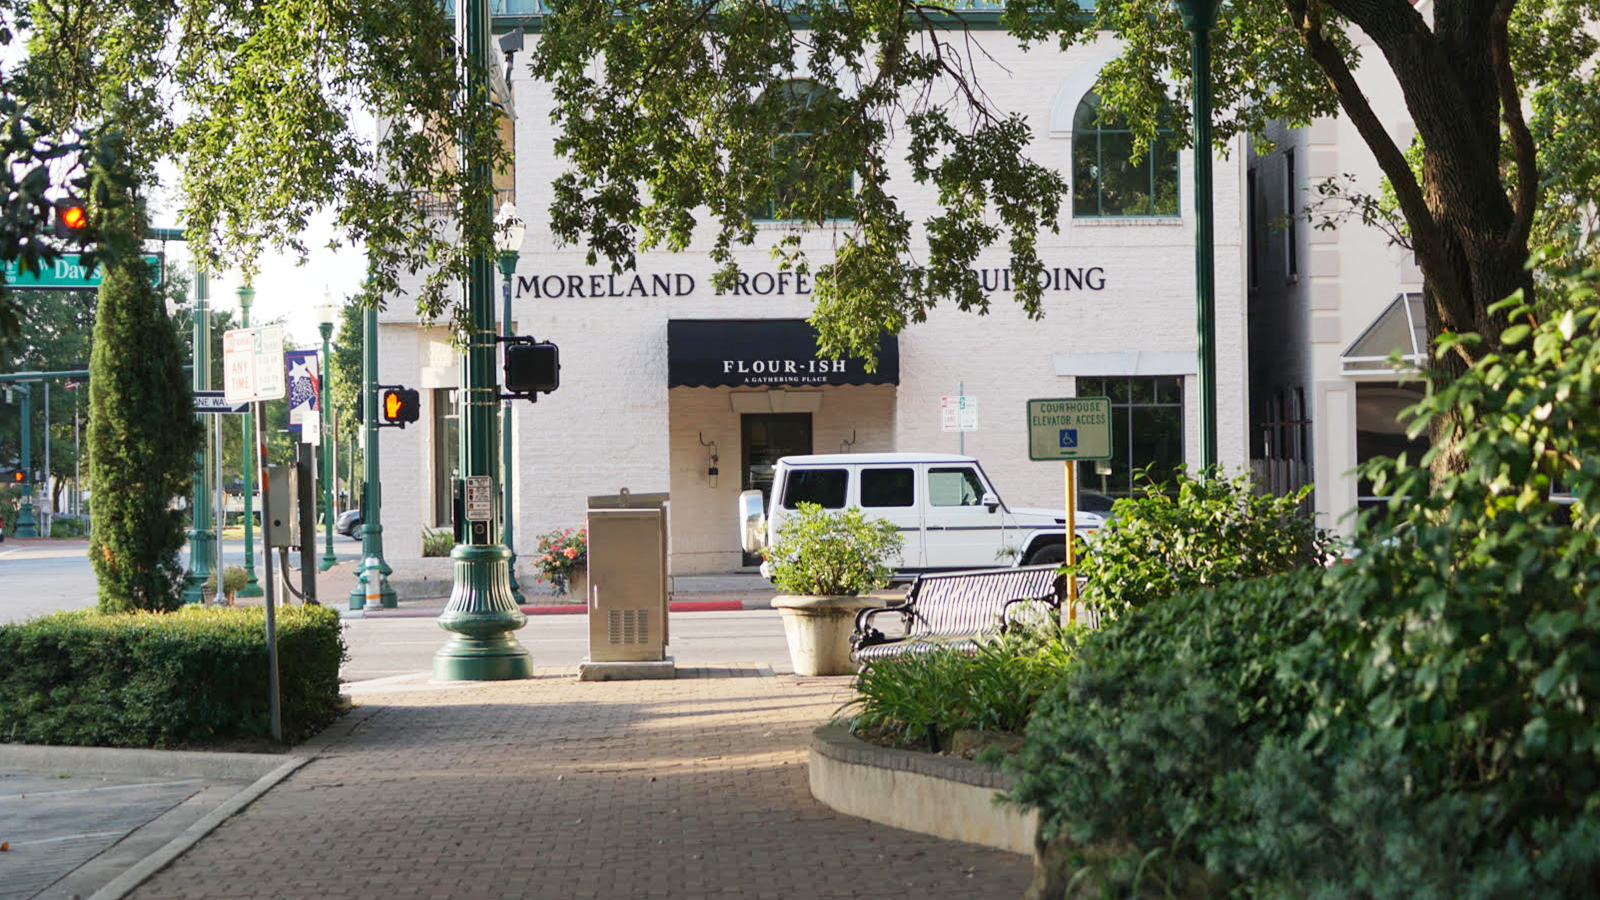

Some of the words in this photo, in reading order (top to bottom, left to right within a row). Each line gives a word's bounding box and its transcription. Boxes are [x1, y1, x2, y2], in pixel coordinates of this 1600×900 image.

[54, 259, 102, 279] Davs
[515, 273, 695, 299] MORELAND
[232, 360, 249, 375] ANY
[722, 360, 847, 373] FLOUR-ISH
[231, 376, 250, 391] TIME
[212, 398, 228, 406] WA
[1040, 402, 1101, 413] COURTHOUSE
[1032, 415, 1072, 426] ELEVATOR
[1076, 414, 1106, 425] ACCESS
